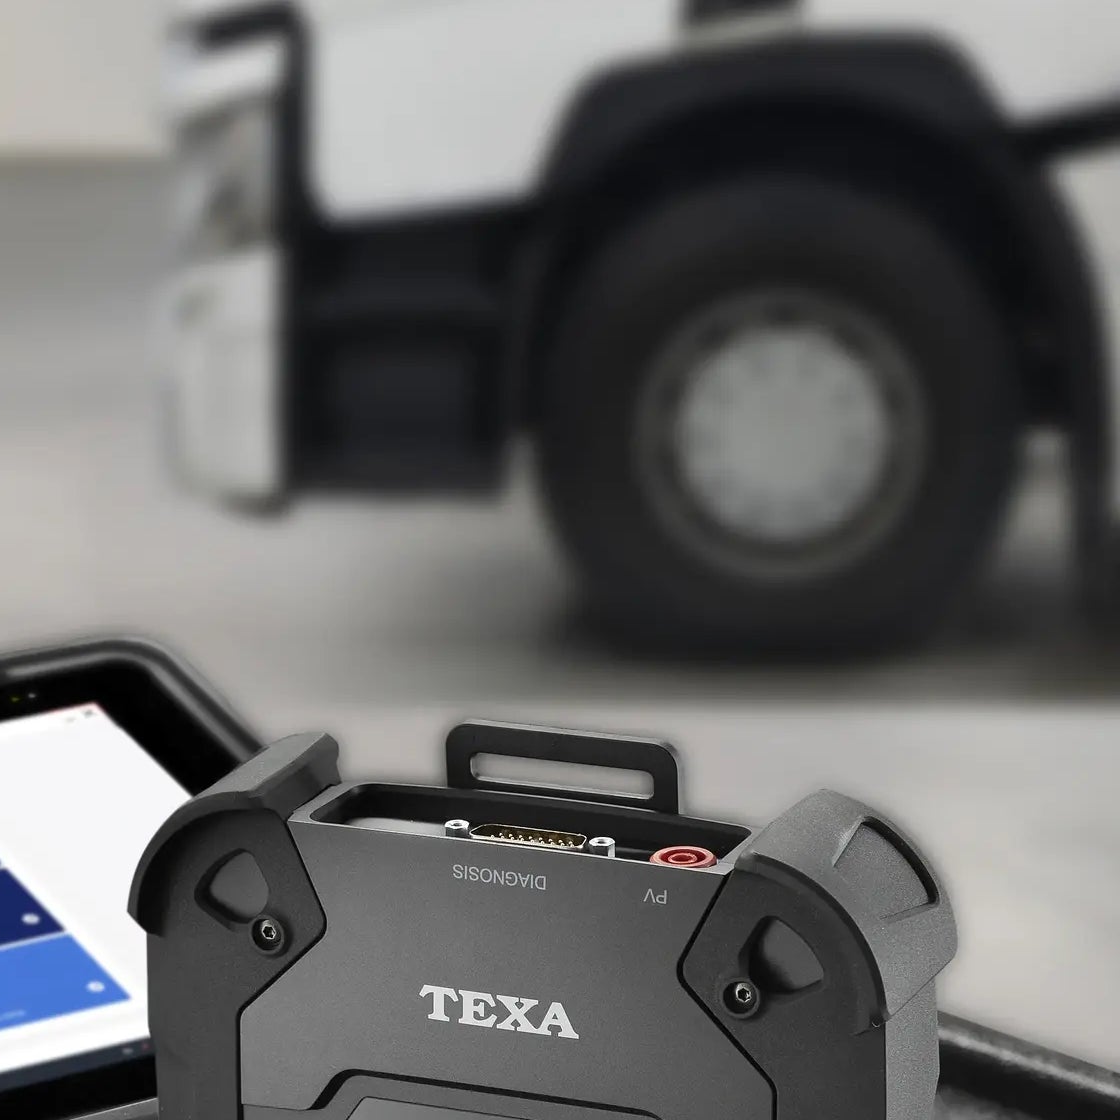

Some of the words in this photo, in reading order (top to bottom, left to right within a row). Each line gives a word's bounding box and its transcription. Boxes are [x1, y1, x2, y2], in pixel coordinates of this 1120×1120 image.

[453, 863, 547, 890] DIAGNOSIS
[643, 887, 668, 905] PV
[419, 984, 579, 1039] TEXA
